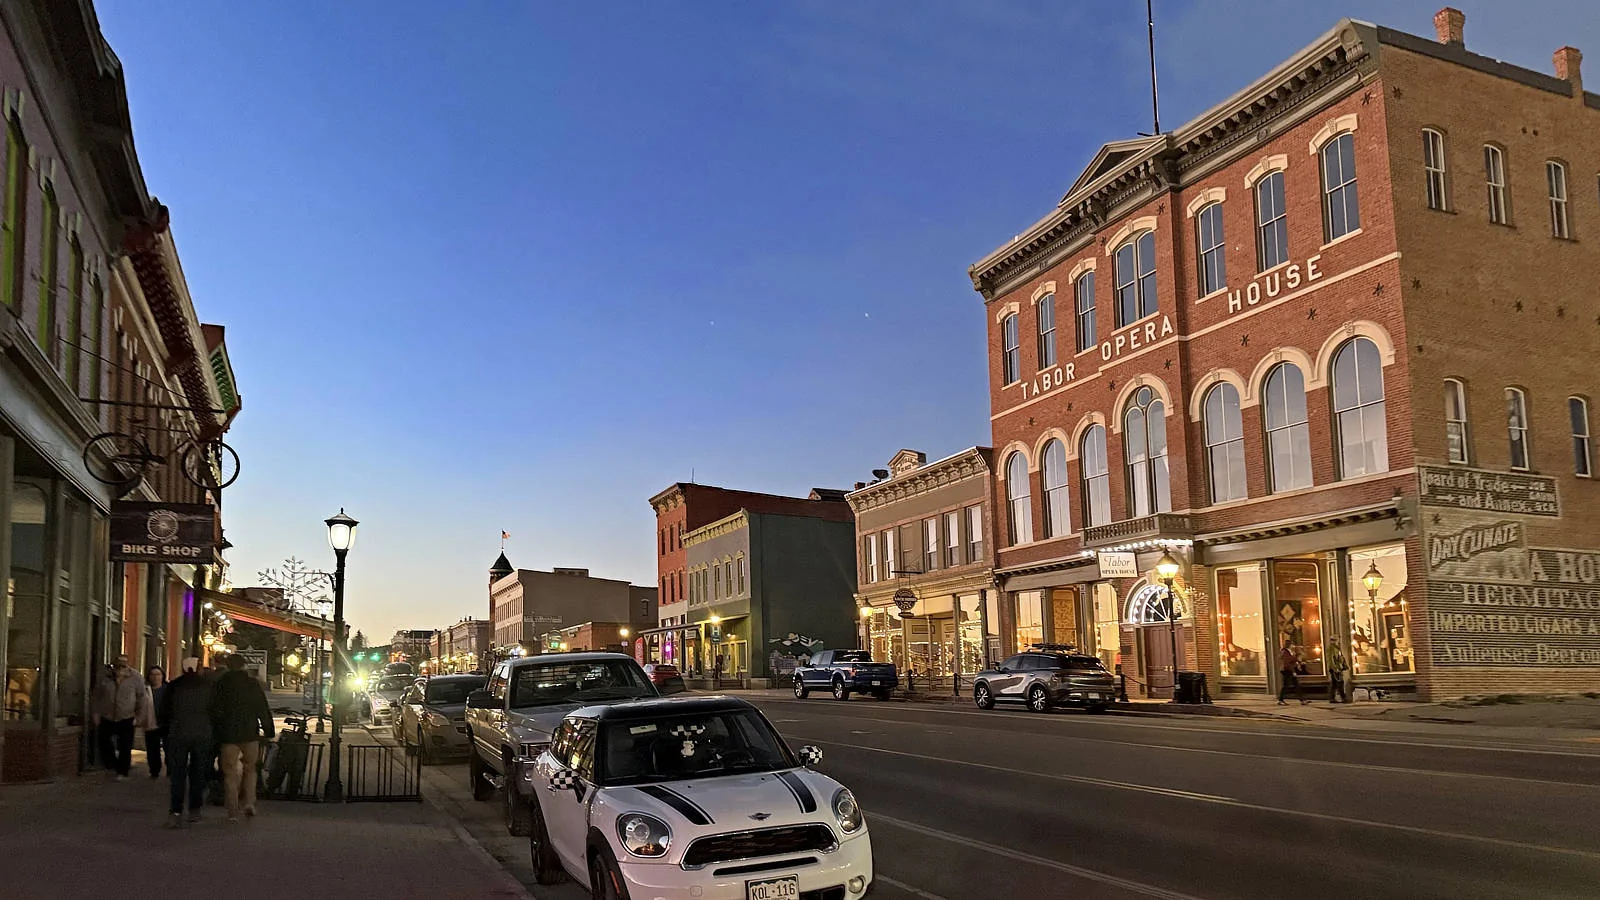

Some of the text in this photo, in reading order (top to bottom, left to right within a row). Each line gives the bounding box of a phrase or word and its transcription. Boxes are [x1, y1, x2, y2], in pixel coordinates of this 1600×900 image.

[1020, 255, 1323, 400] TABOR OPERA HOUSE
[1420, 467, 1510, 495] Board of Trade
[1458, 491, 1482, 508] and
[122, 544, 202, 557] BIKE SHOP
[1431, 523, 1519, 567] DRY CLIMATE
[1104, 556, 1130, 567] Tabor
[1556, 552, 1600, 584] HO
[1434, 610, 1519, 634] IMPORTED
